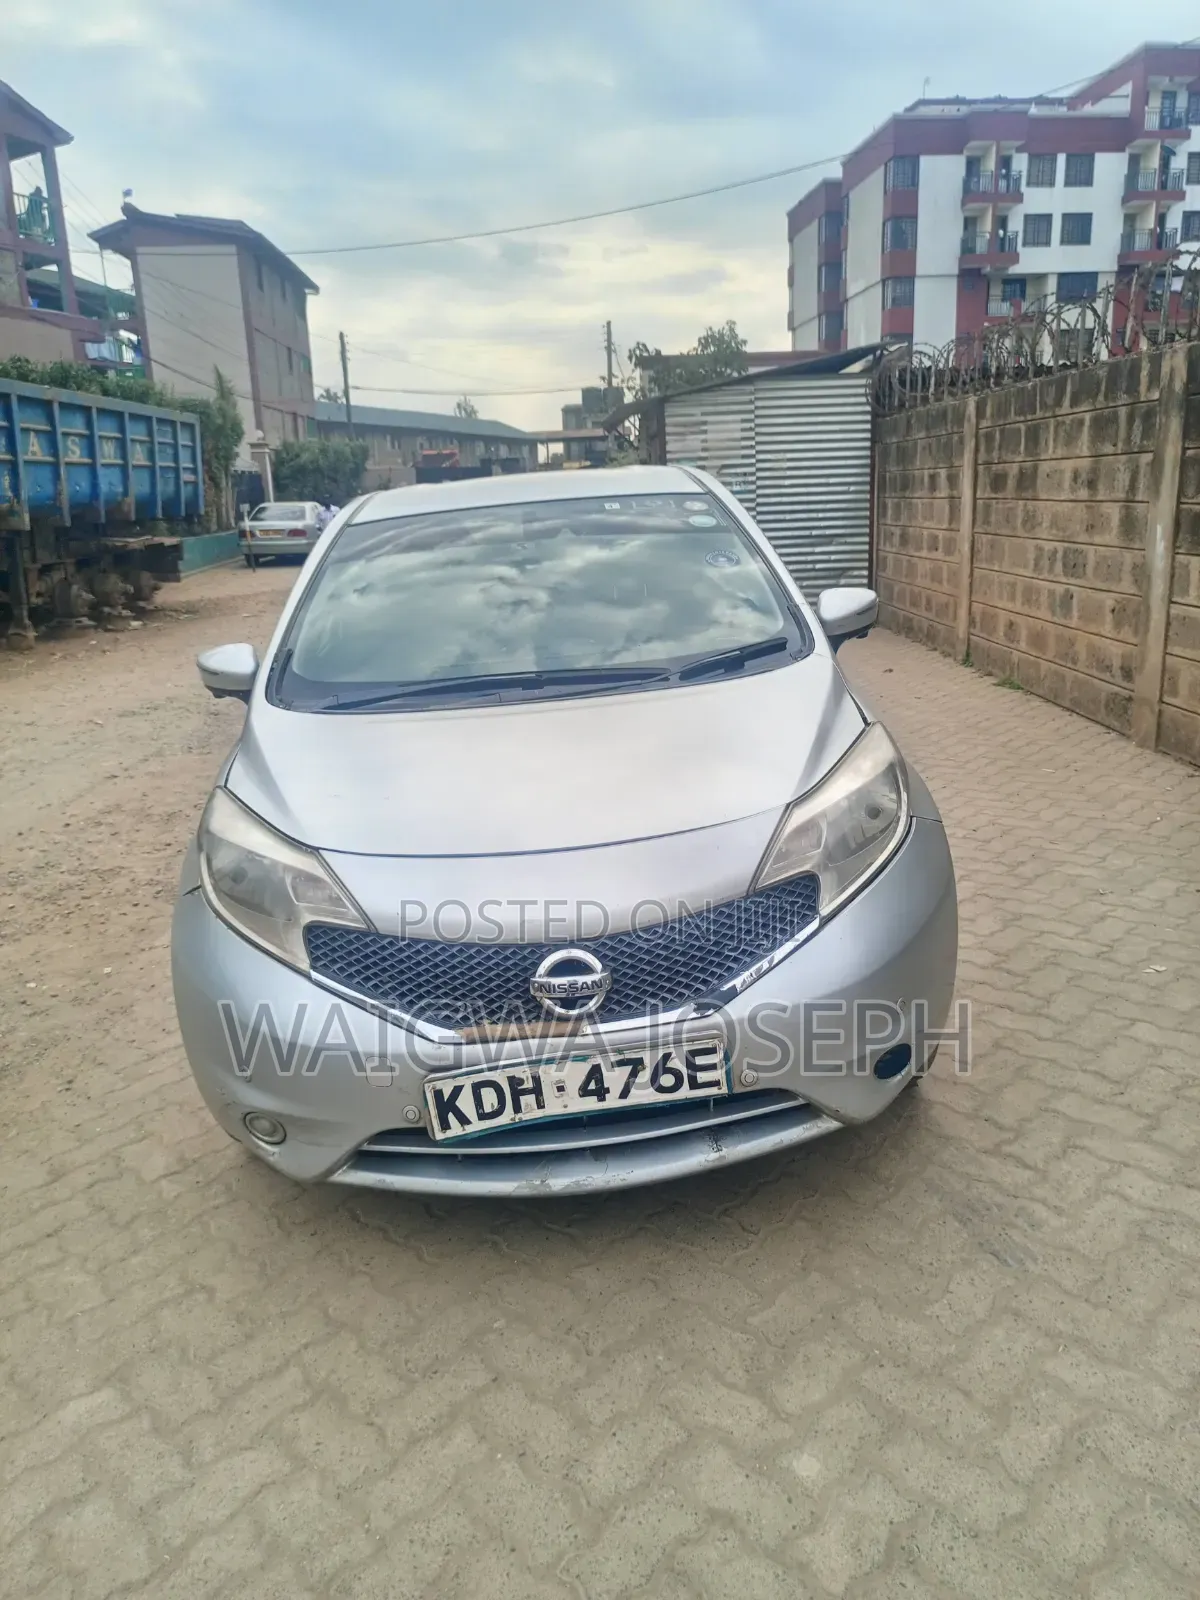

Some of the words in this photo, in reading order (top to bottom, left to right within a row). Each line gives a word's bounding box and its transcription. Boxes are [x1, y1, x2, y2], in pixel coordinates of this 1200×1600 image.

[539, 978, 603, 994] NISSAN
[433, 1072, 546, 1131] KDH
[578, 1047, 721, 1102] 476E
